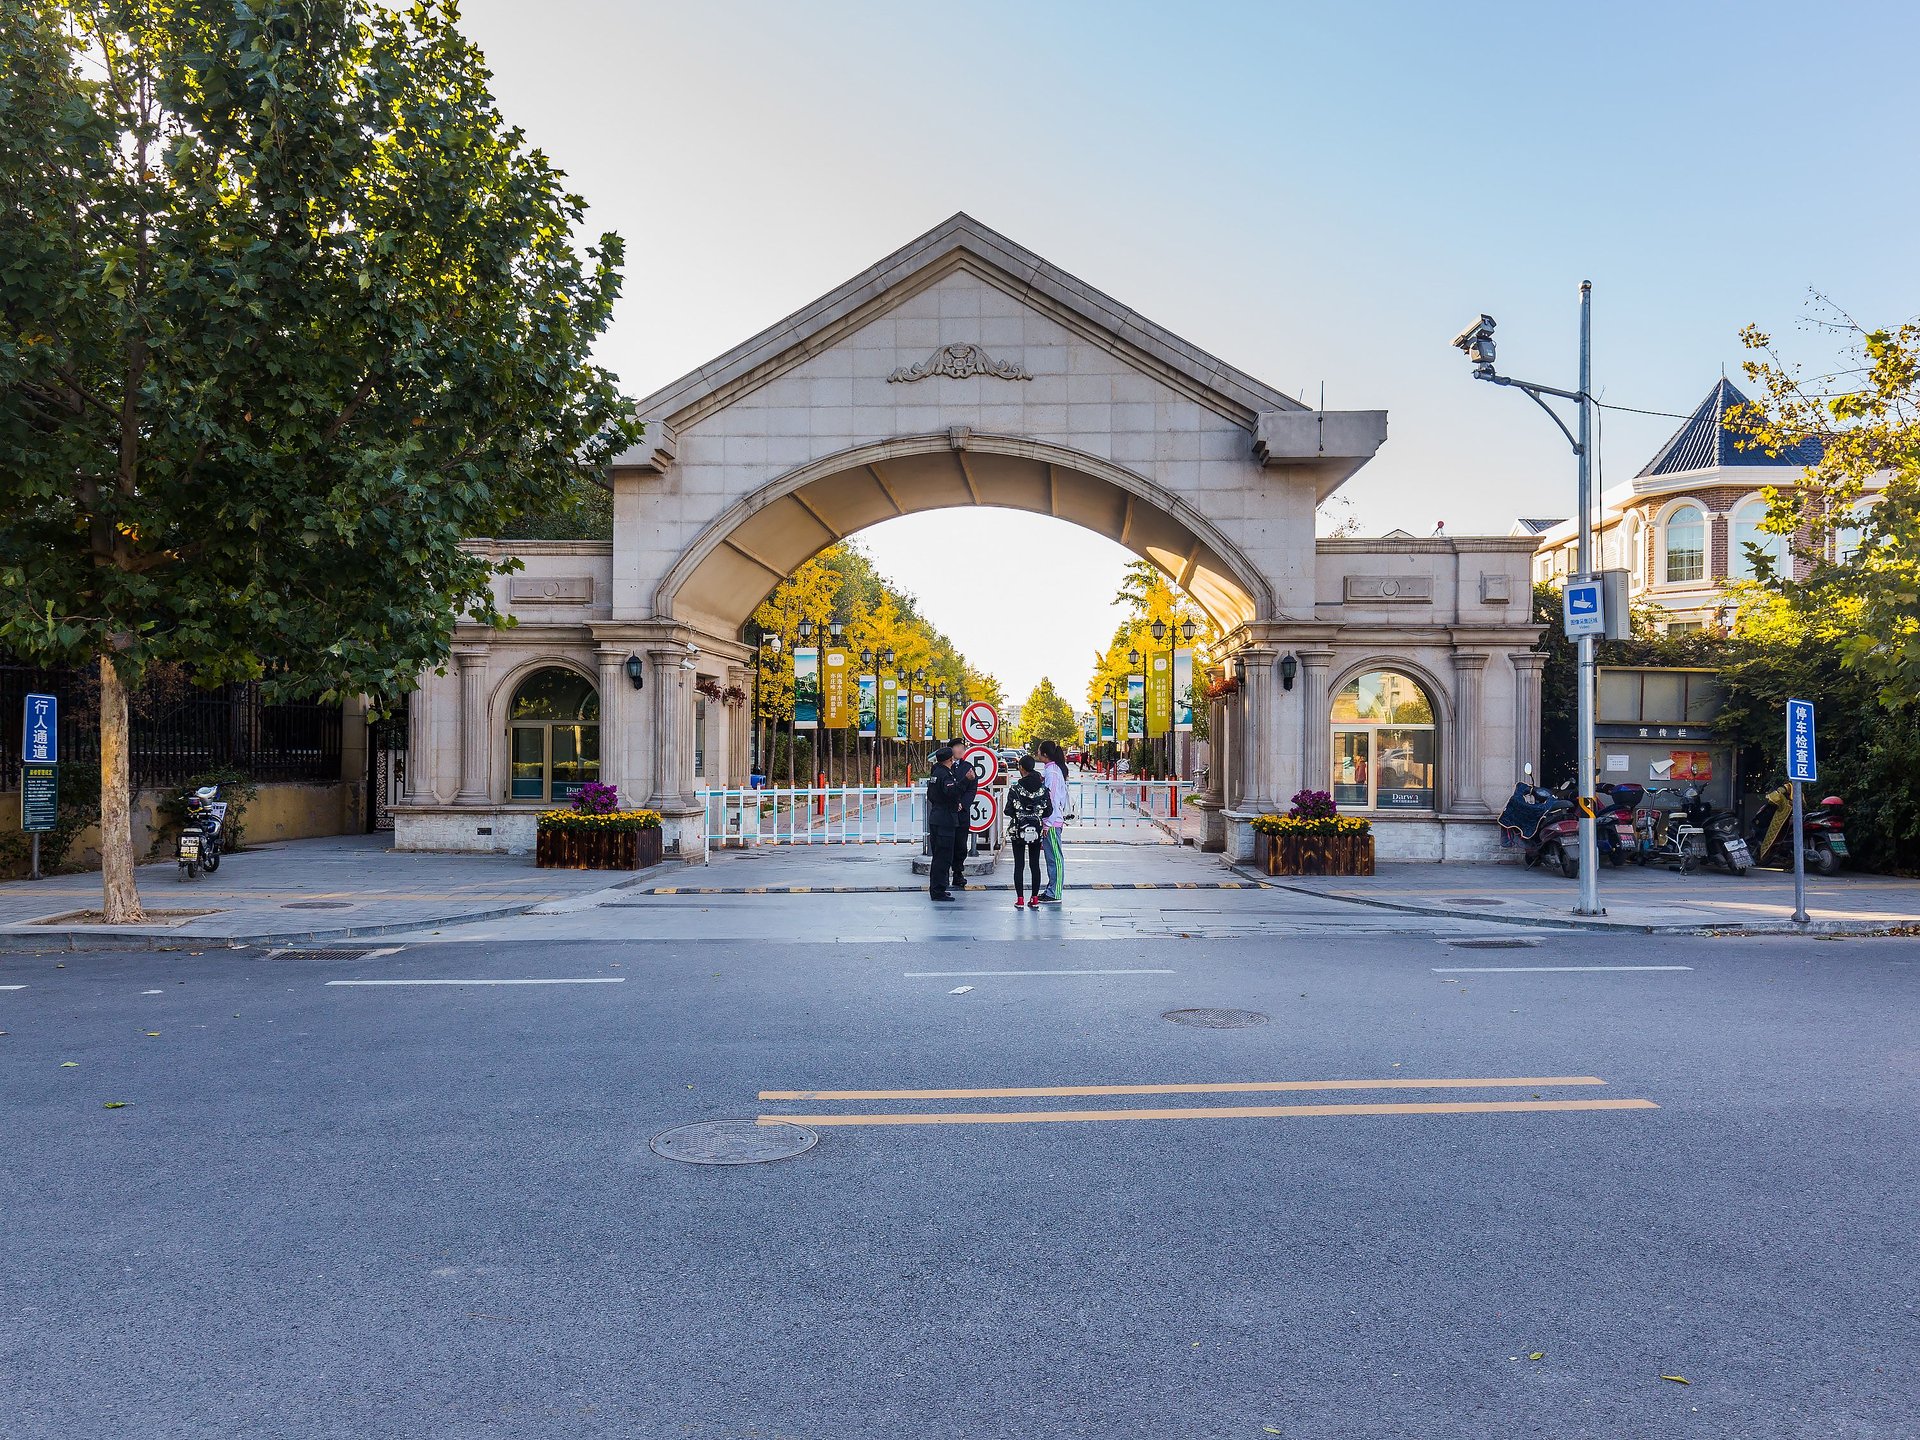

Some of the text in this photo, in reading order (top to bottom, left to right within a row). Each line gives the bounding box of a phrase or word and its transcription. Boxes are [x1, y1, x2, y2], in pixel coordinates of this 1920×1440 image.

[32, 700, 48, 759] 行人通道
[1639, 728, 1687, 737] 宣传栏
[1795, 706, 1808, 777] 停车检查区
[973, 755, 986, 780] 5
[970, 801, 987, 821] 3t
